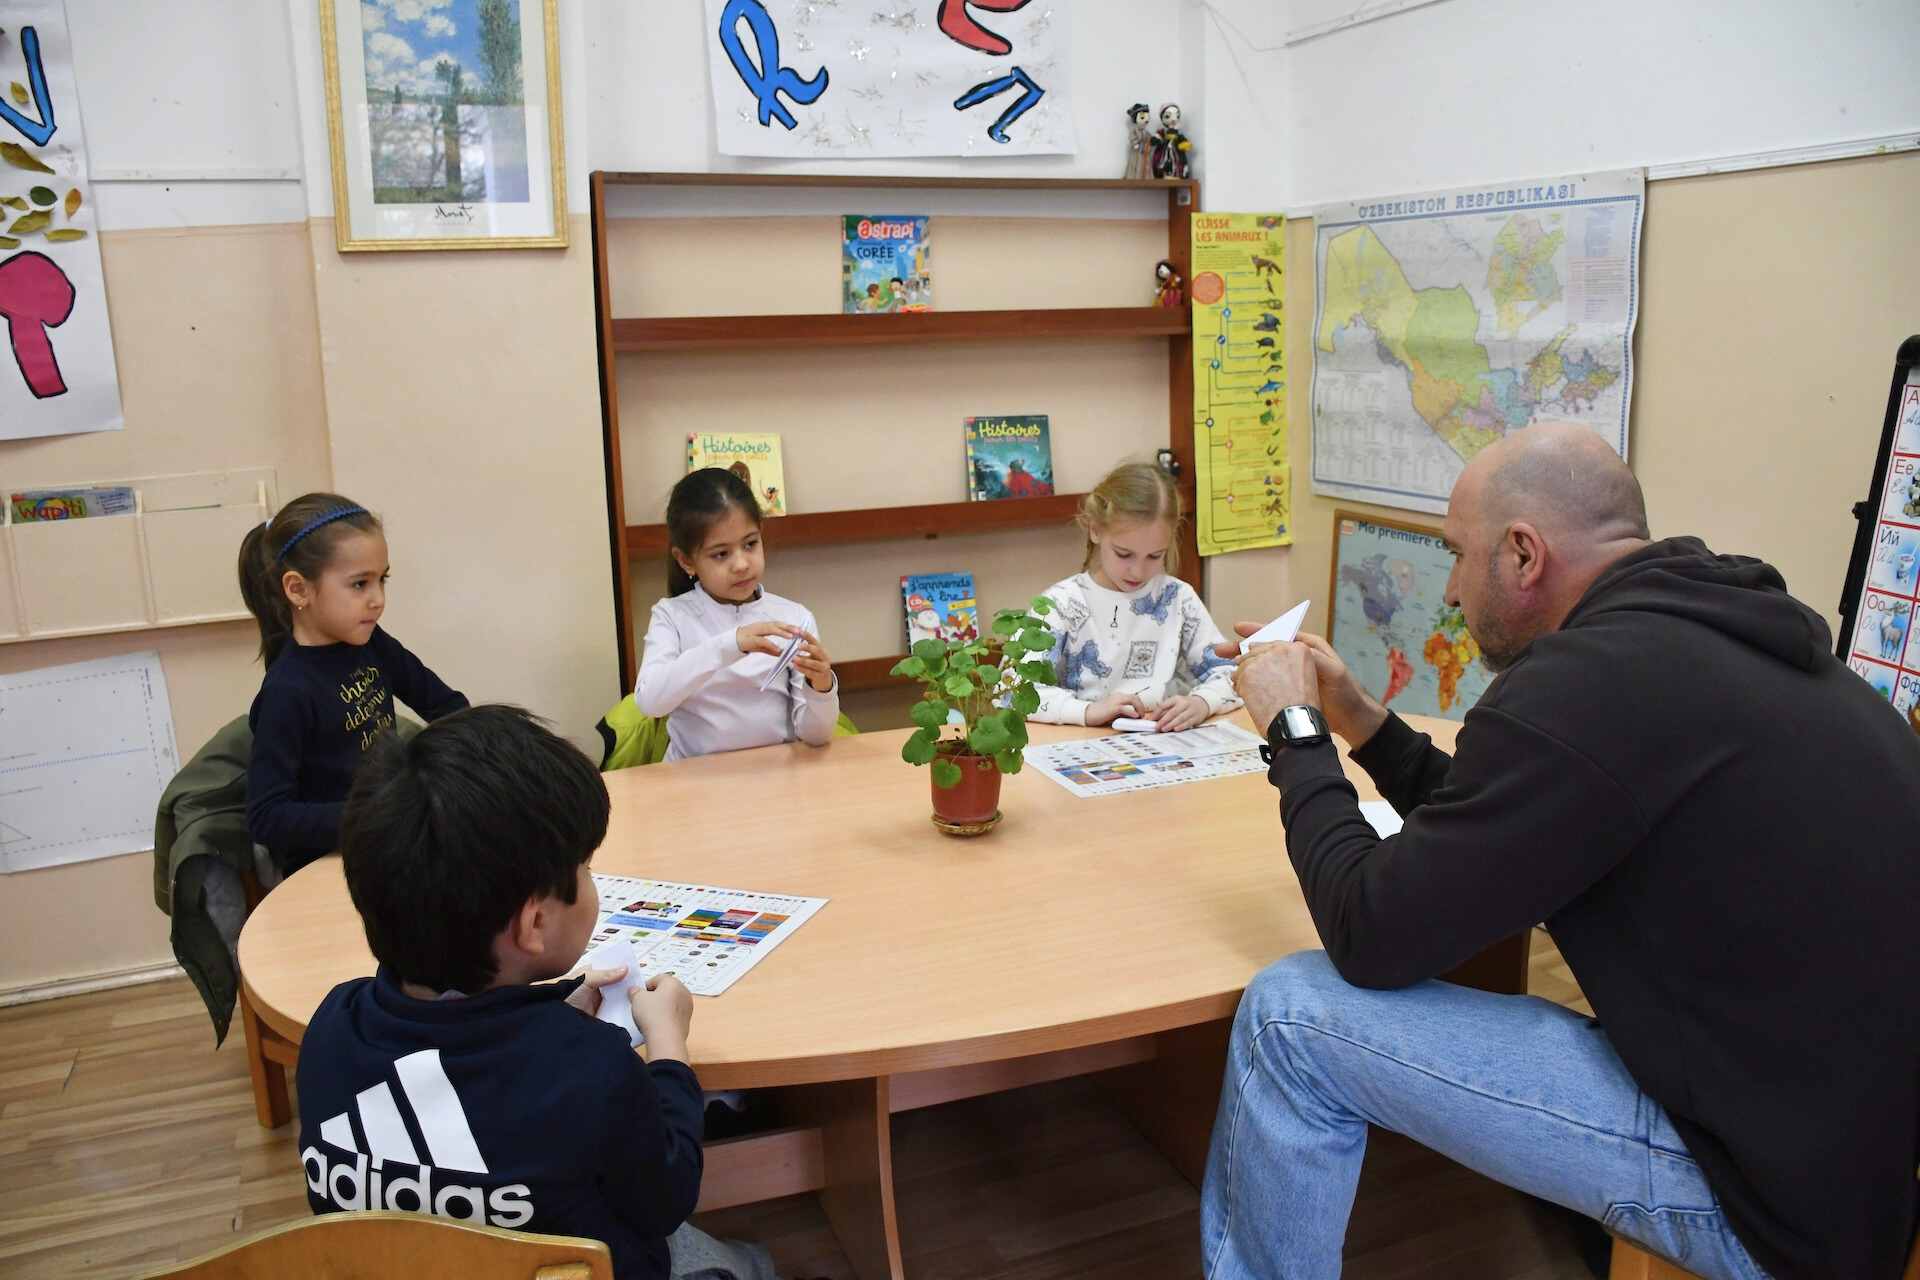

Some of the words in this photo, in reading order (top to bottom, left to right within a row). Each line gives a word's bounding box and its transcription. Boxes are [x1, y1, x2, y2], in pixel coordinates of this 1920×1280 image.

[1456, 183, 1576, 209] RESPUBLIKASI
[857, 219, 915, 239] astrapi
[1196, 218, 1230, 230] CLASSE
[1196, 232, 1212, 243] LES
[1215, 231, 1262, 242] ANIMAUX
[856, 245, 894, 260] CORÉE
[979, 420, 1041, 438] Histoires
[703, 434, 771, 454] Histoires
[18, 499, 83, 520] wapiti
[1358, 521, 1376, 534] Ma
[939, 590, 959, 601] lire
[301, 1146, 534, 1228] adidas
